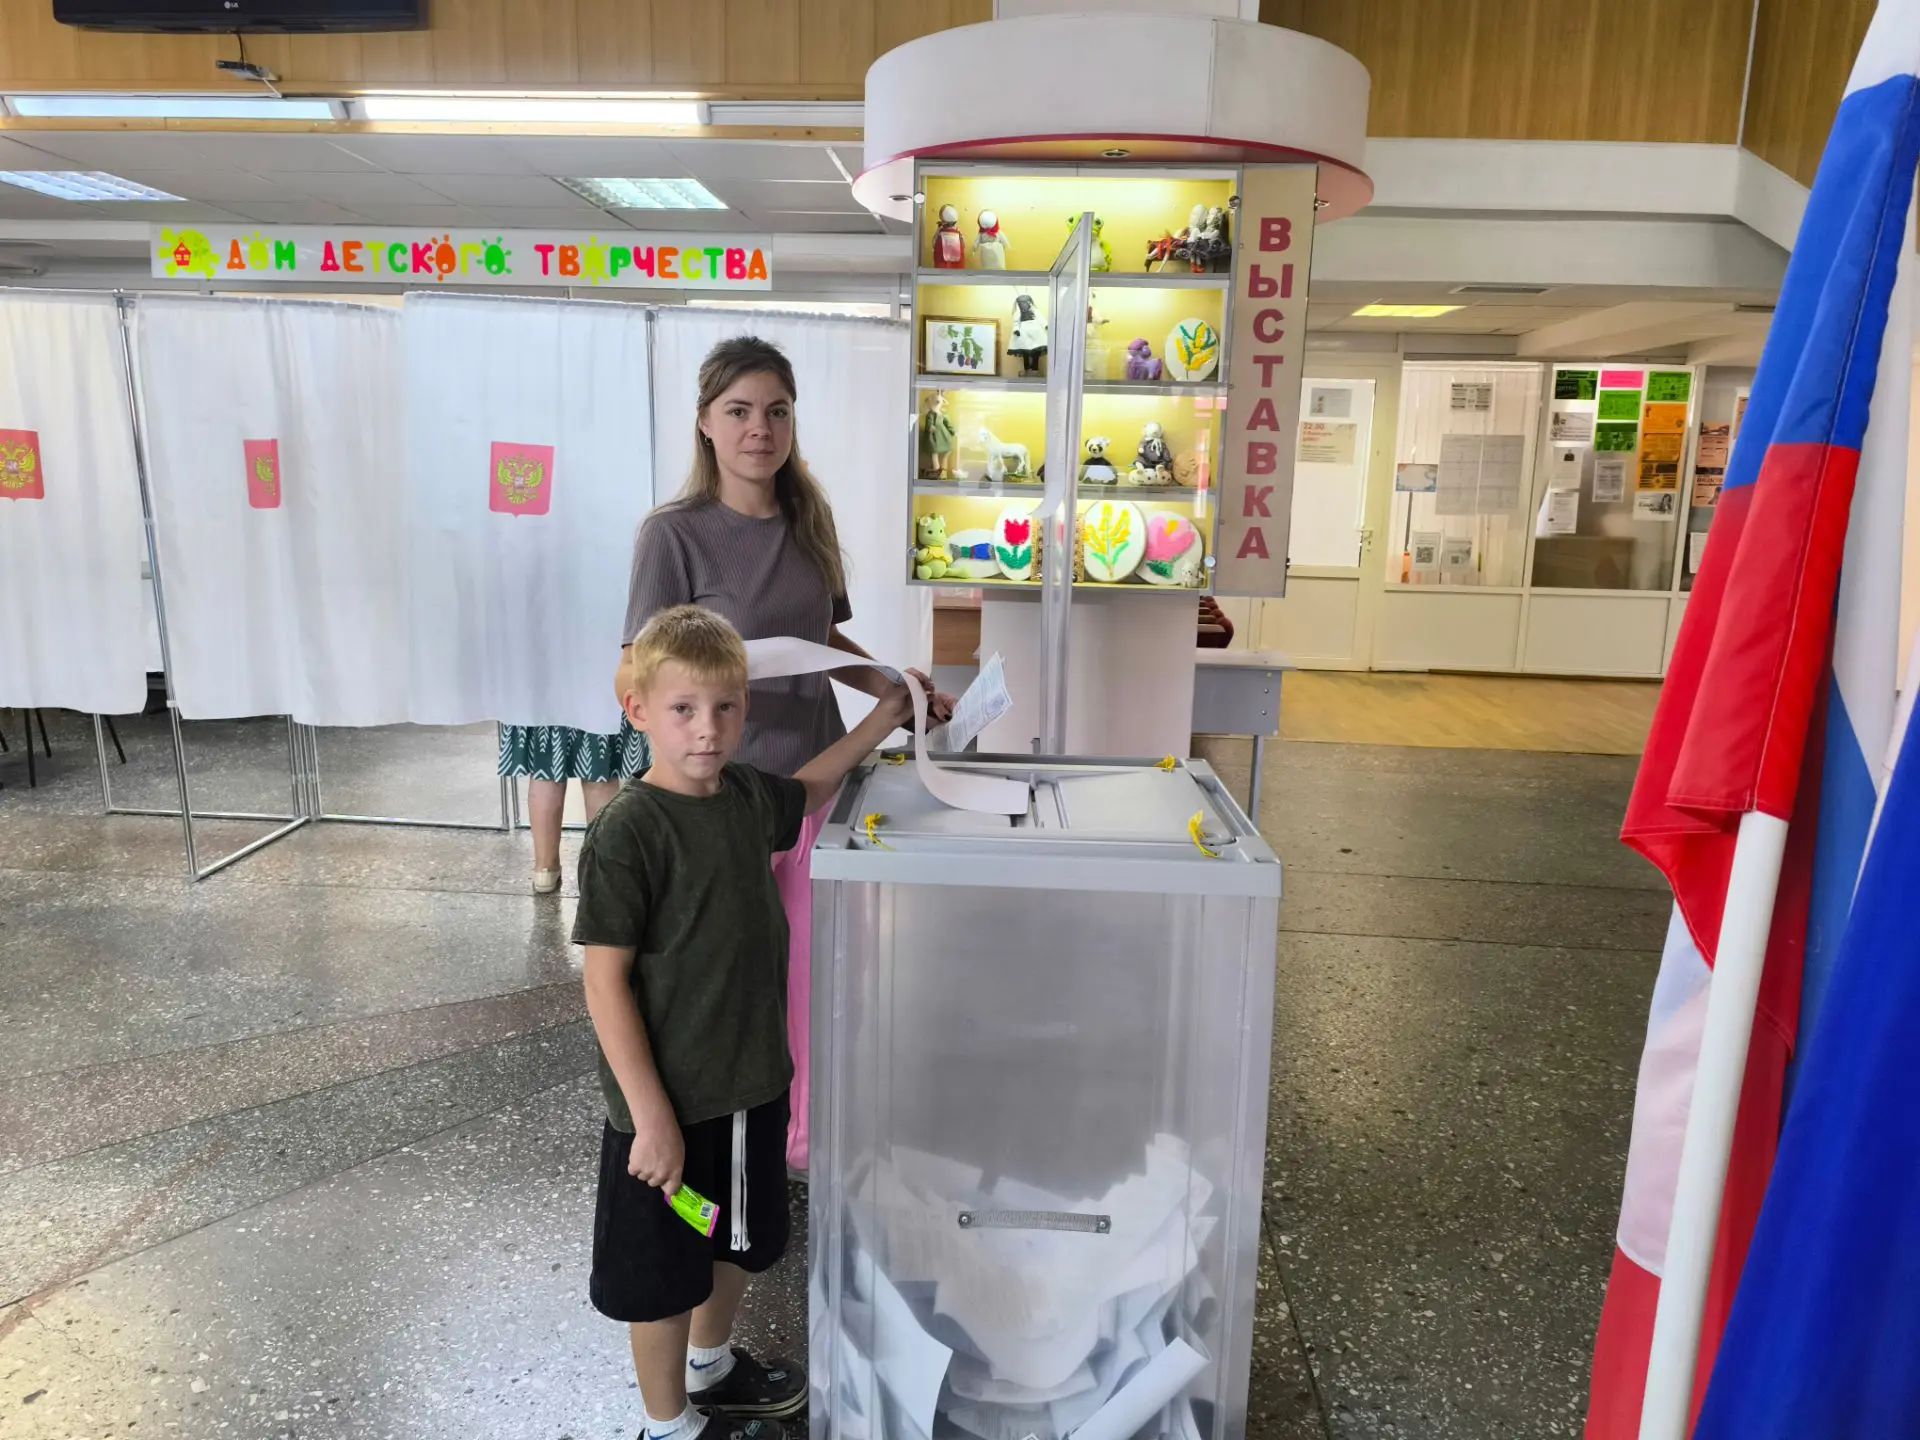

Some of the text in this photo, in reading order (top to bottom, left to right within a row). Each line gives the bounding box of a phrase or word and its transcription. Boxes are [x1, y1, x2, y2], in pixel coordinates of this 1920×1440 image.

[226, 233, 768, 282] ДОМ ДЕТСКОГО ТВОРЧЕСТВА
[1236, 217, 1294, 559] ВЫСТАВКА
